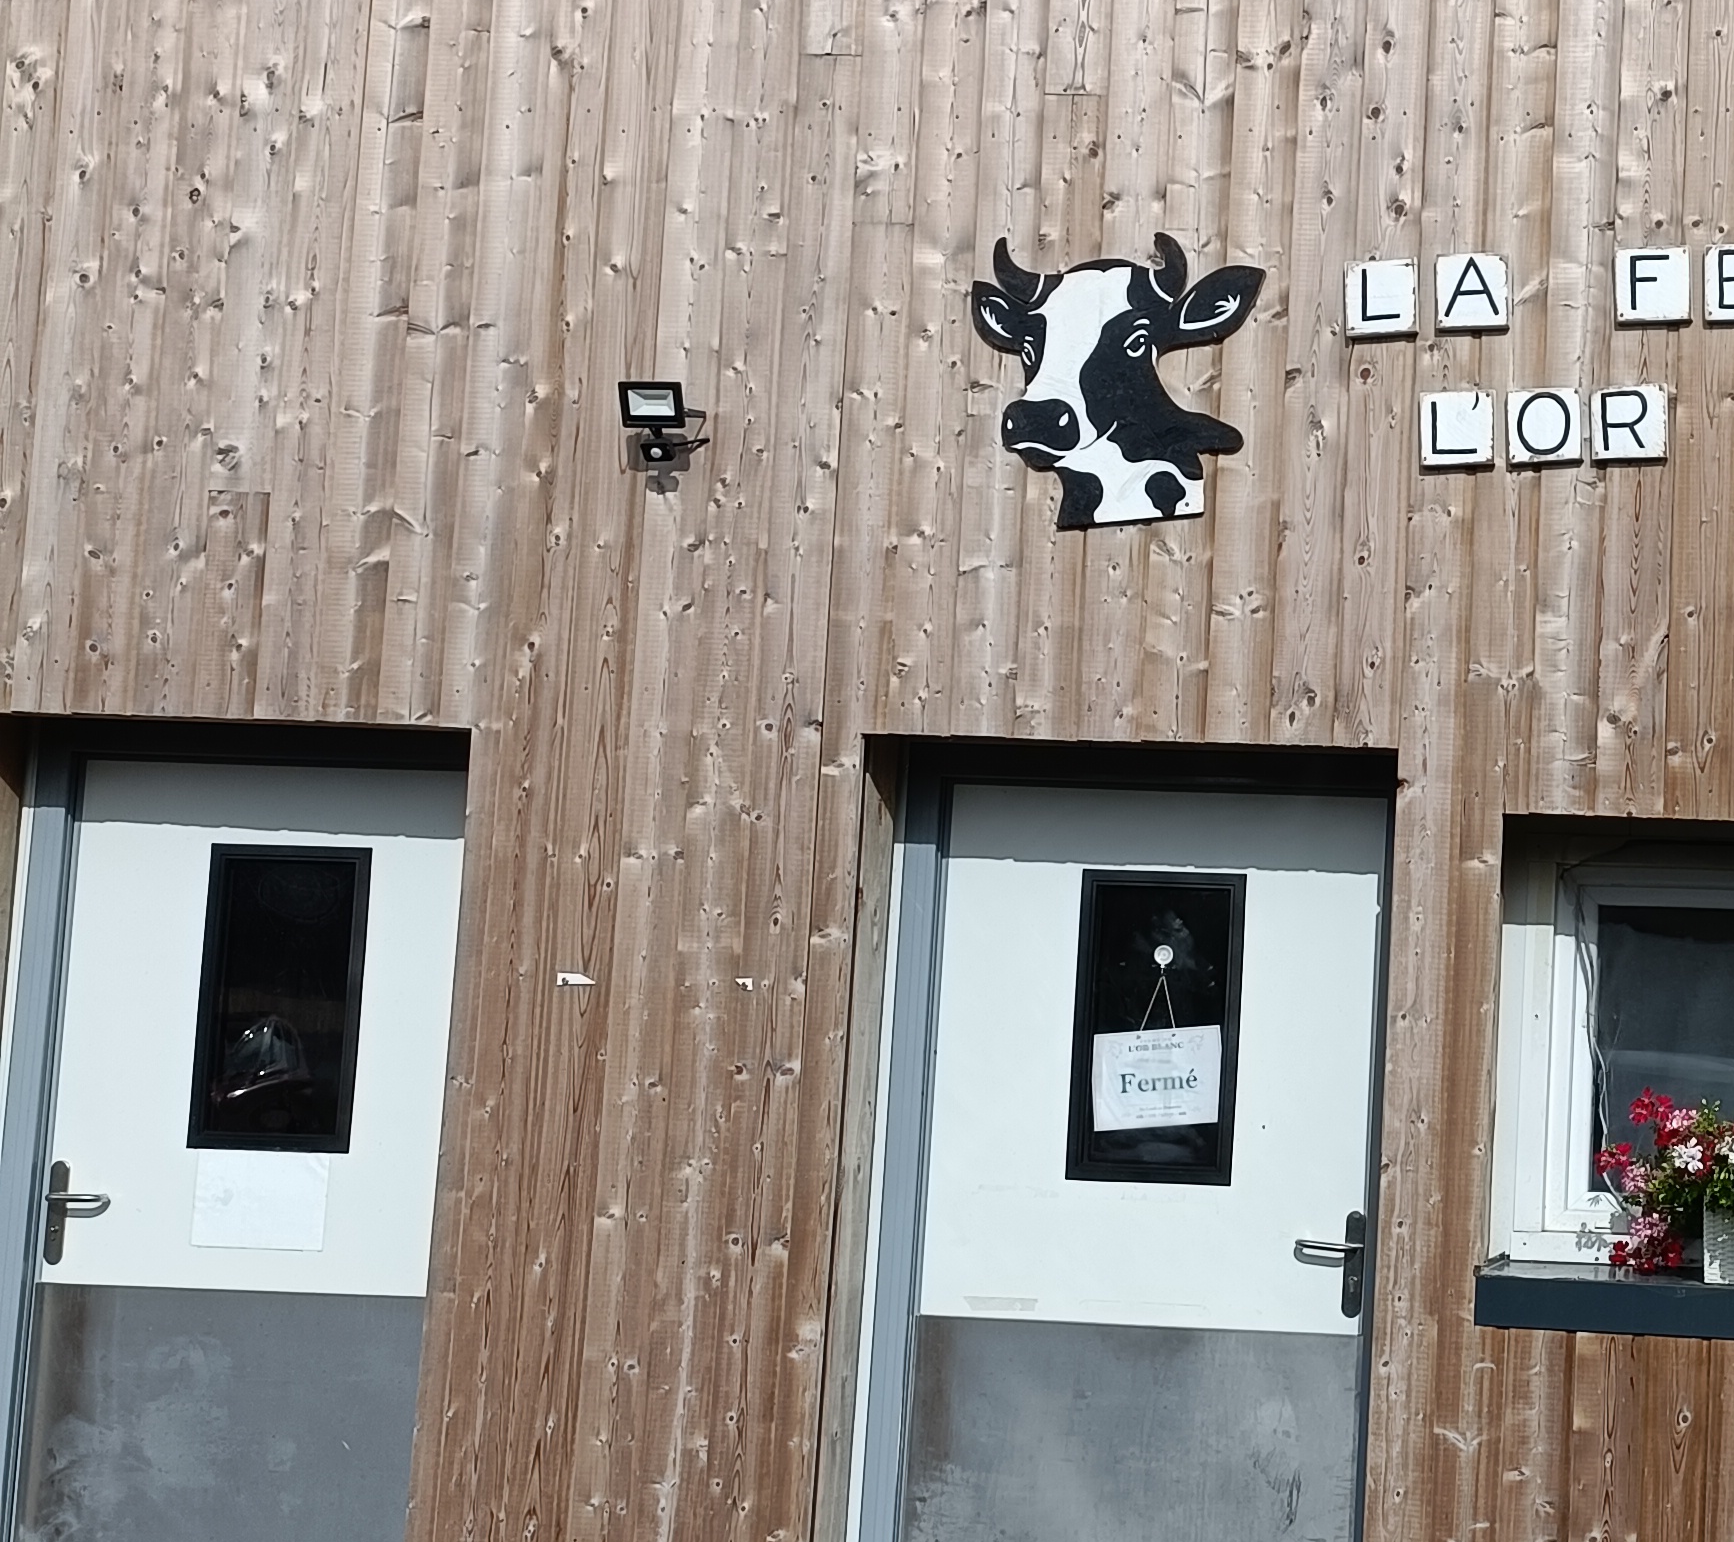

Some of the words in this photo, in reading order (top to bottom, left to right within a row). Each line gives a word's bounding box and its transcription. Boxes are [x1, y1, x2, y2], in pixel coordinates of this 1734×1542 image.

[1360, 255, 1501, 321] LA
[1430, 390, 1650, 455] L'OR
[1119, 1068, 1199, 1094] Fermé
